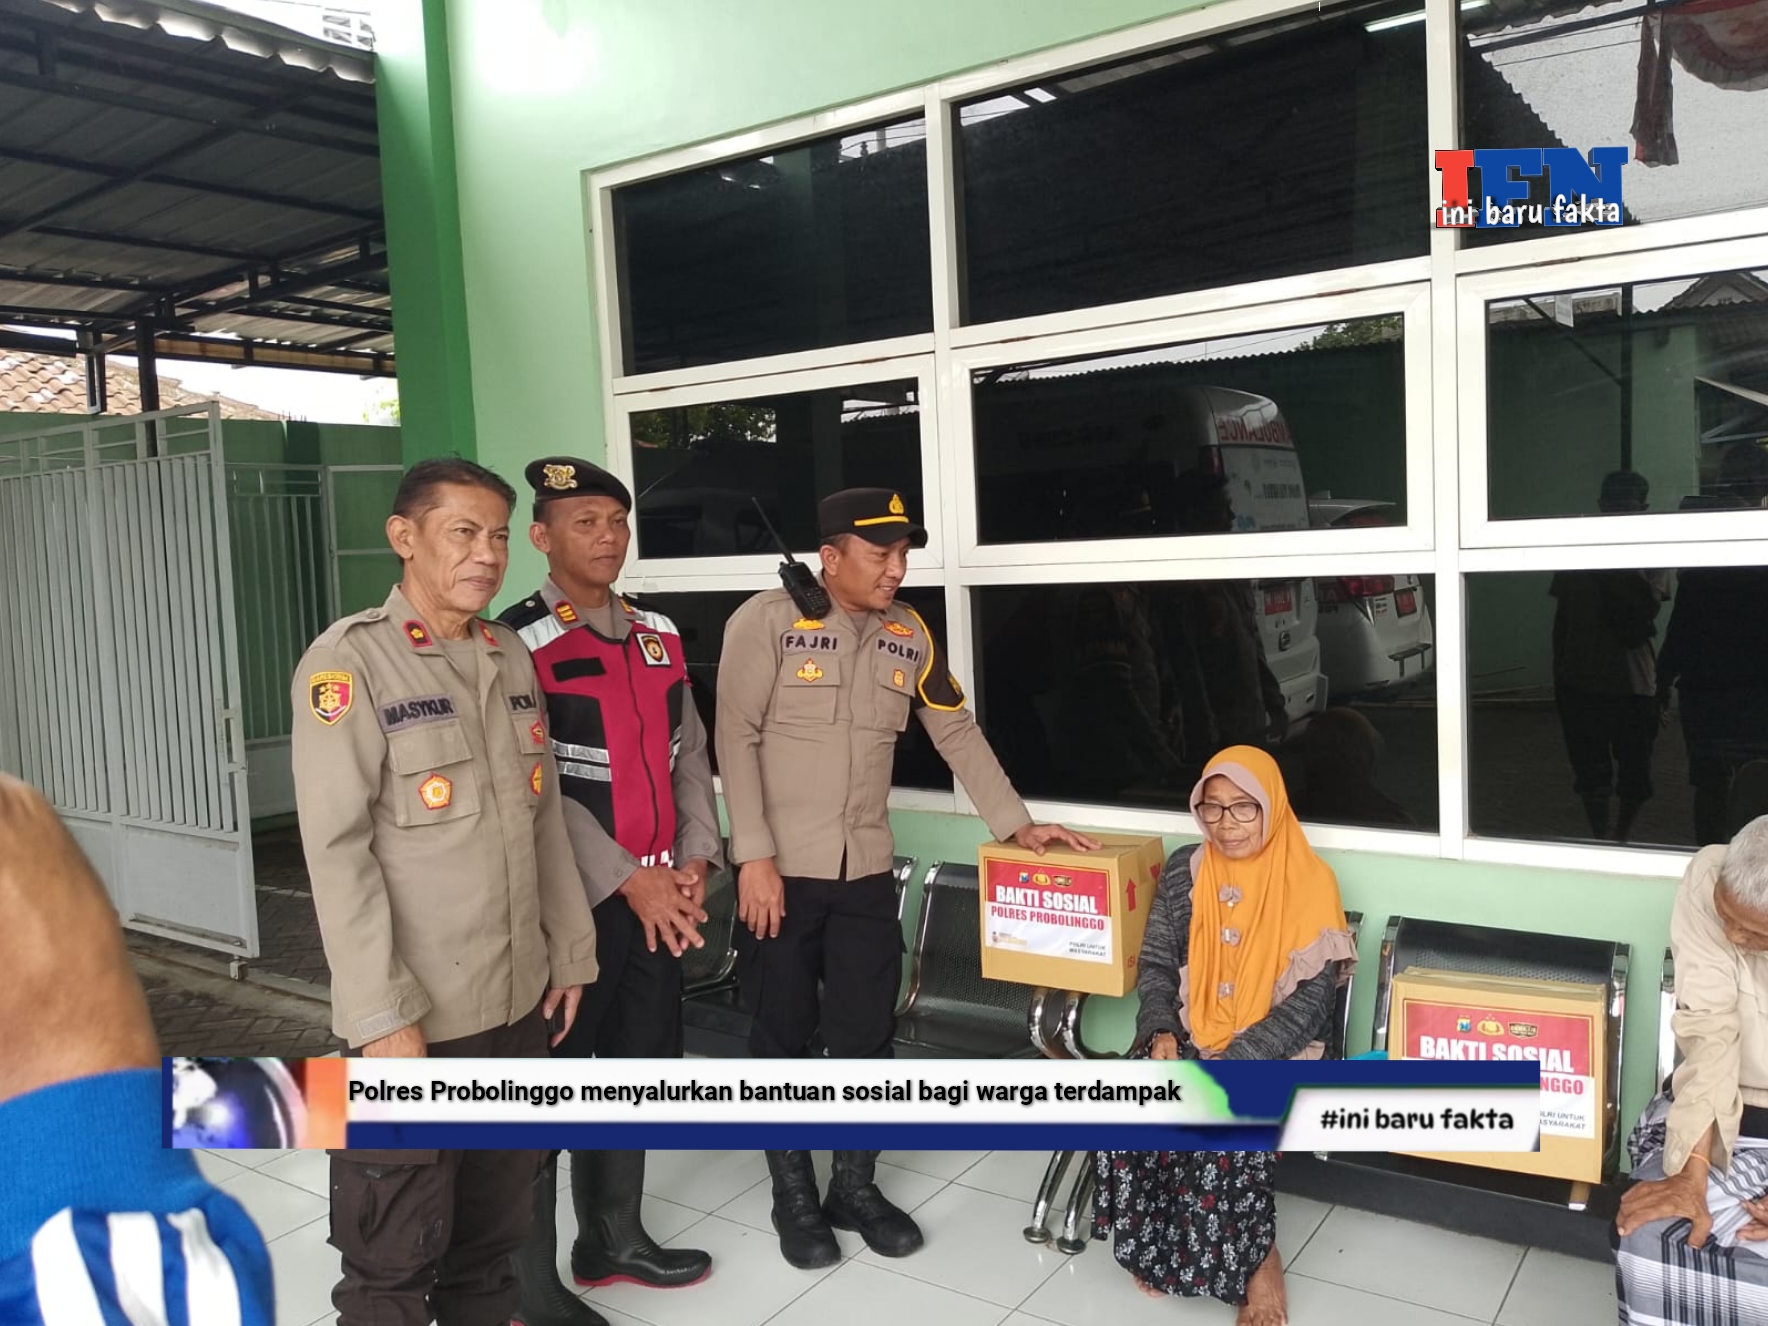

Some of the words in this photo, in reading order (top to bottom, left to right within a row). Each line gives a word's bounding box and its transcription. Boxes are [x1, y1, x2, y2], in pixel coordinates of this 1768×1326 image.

[785, 634, 838, 652] FAJRI
[877, 639, 920, 663] POLRI
[383, 698, 454, 726] MASYKUR
[995, 885, 1039, 908] BAKTI
[1042, 890, 1098, 914] SOSIAL
[991, 905, 1027, 921] POLRES
[1029, 910, 1105, 931] PROBOLINGGO
[1420, 1035, 1487, 1060] BAKTI
[1557, 1113, 1586, 1122] UNTUK
